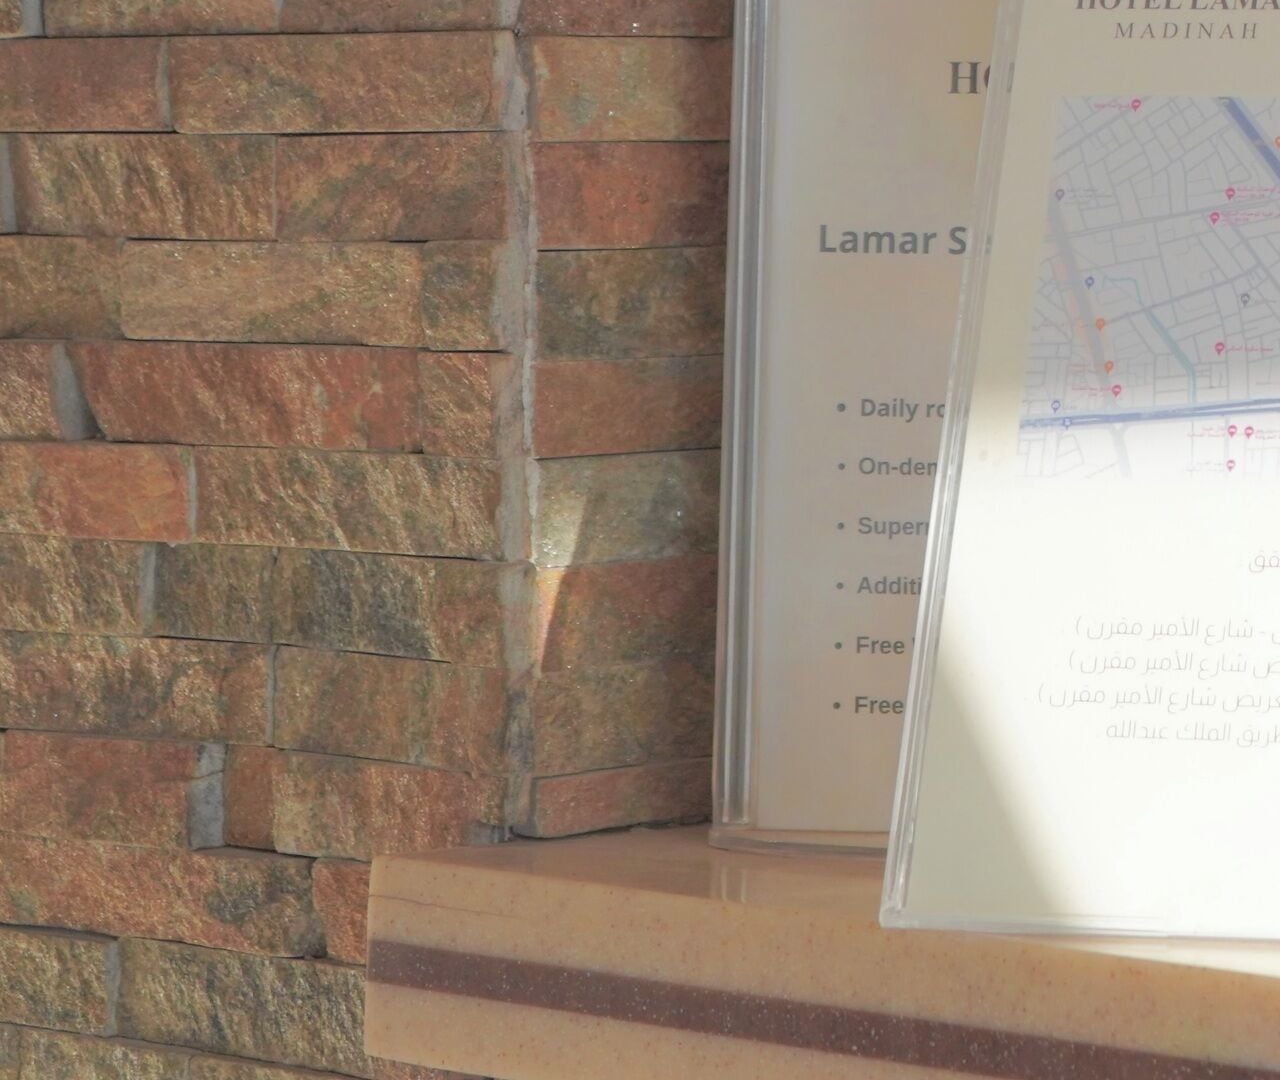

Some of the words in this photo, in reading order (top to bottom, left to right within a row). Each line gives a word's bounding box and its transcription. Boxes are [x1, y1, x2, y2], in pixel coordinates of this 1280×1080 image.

[1113, 22, 1259, 40] MADINAH
[819, 223, 937, 255] Lamar
[861, 398, 919, 424] Daily
[858, 516, 930, 540] Super
[856, 636, 905, 654] Free
[854, 696, 904, 714] Free
